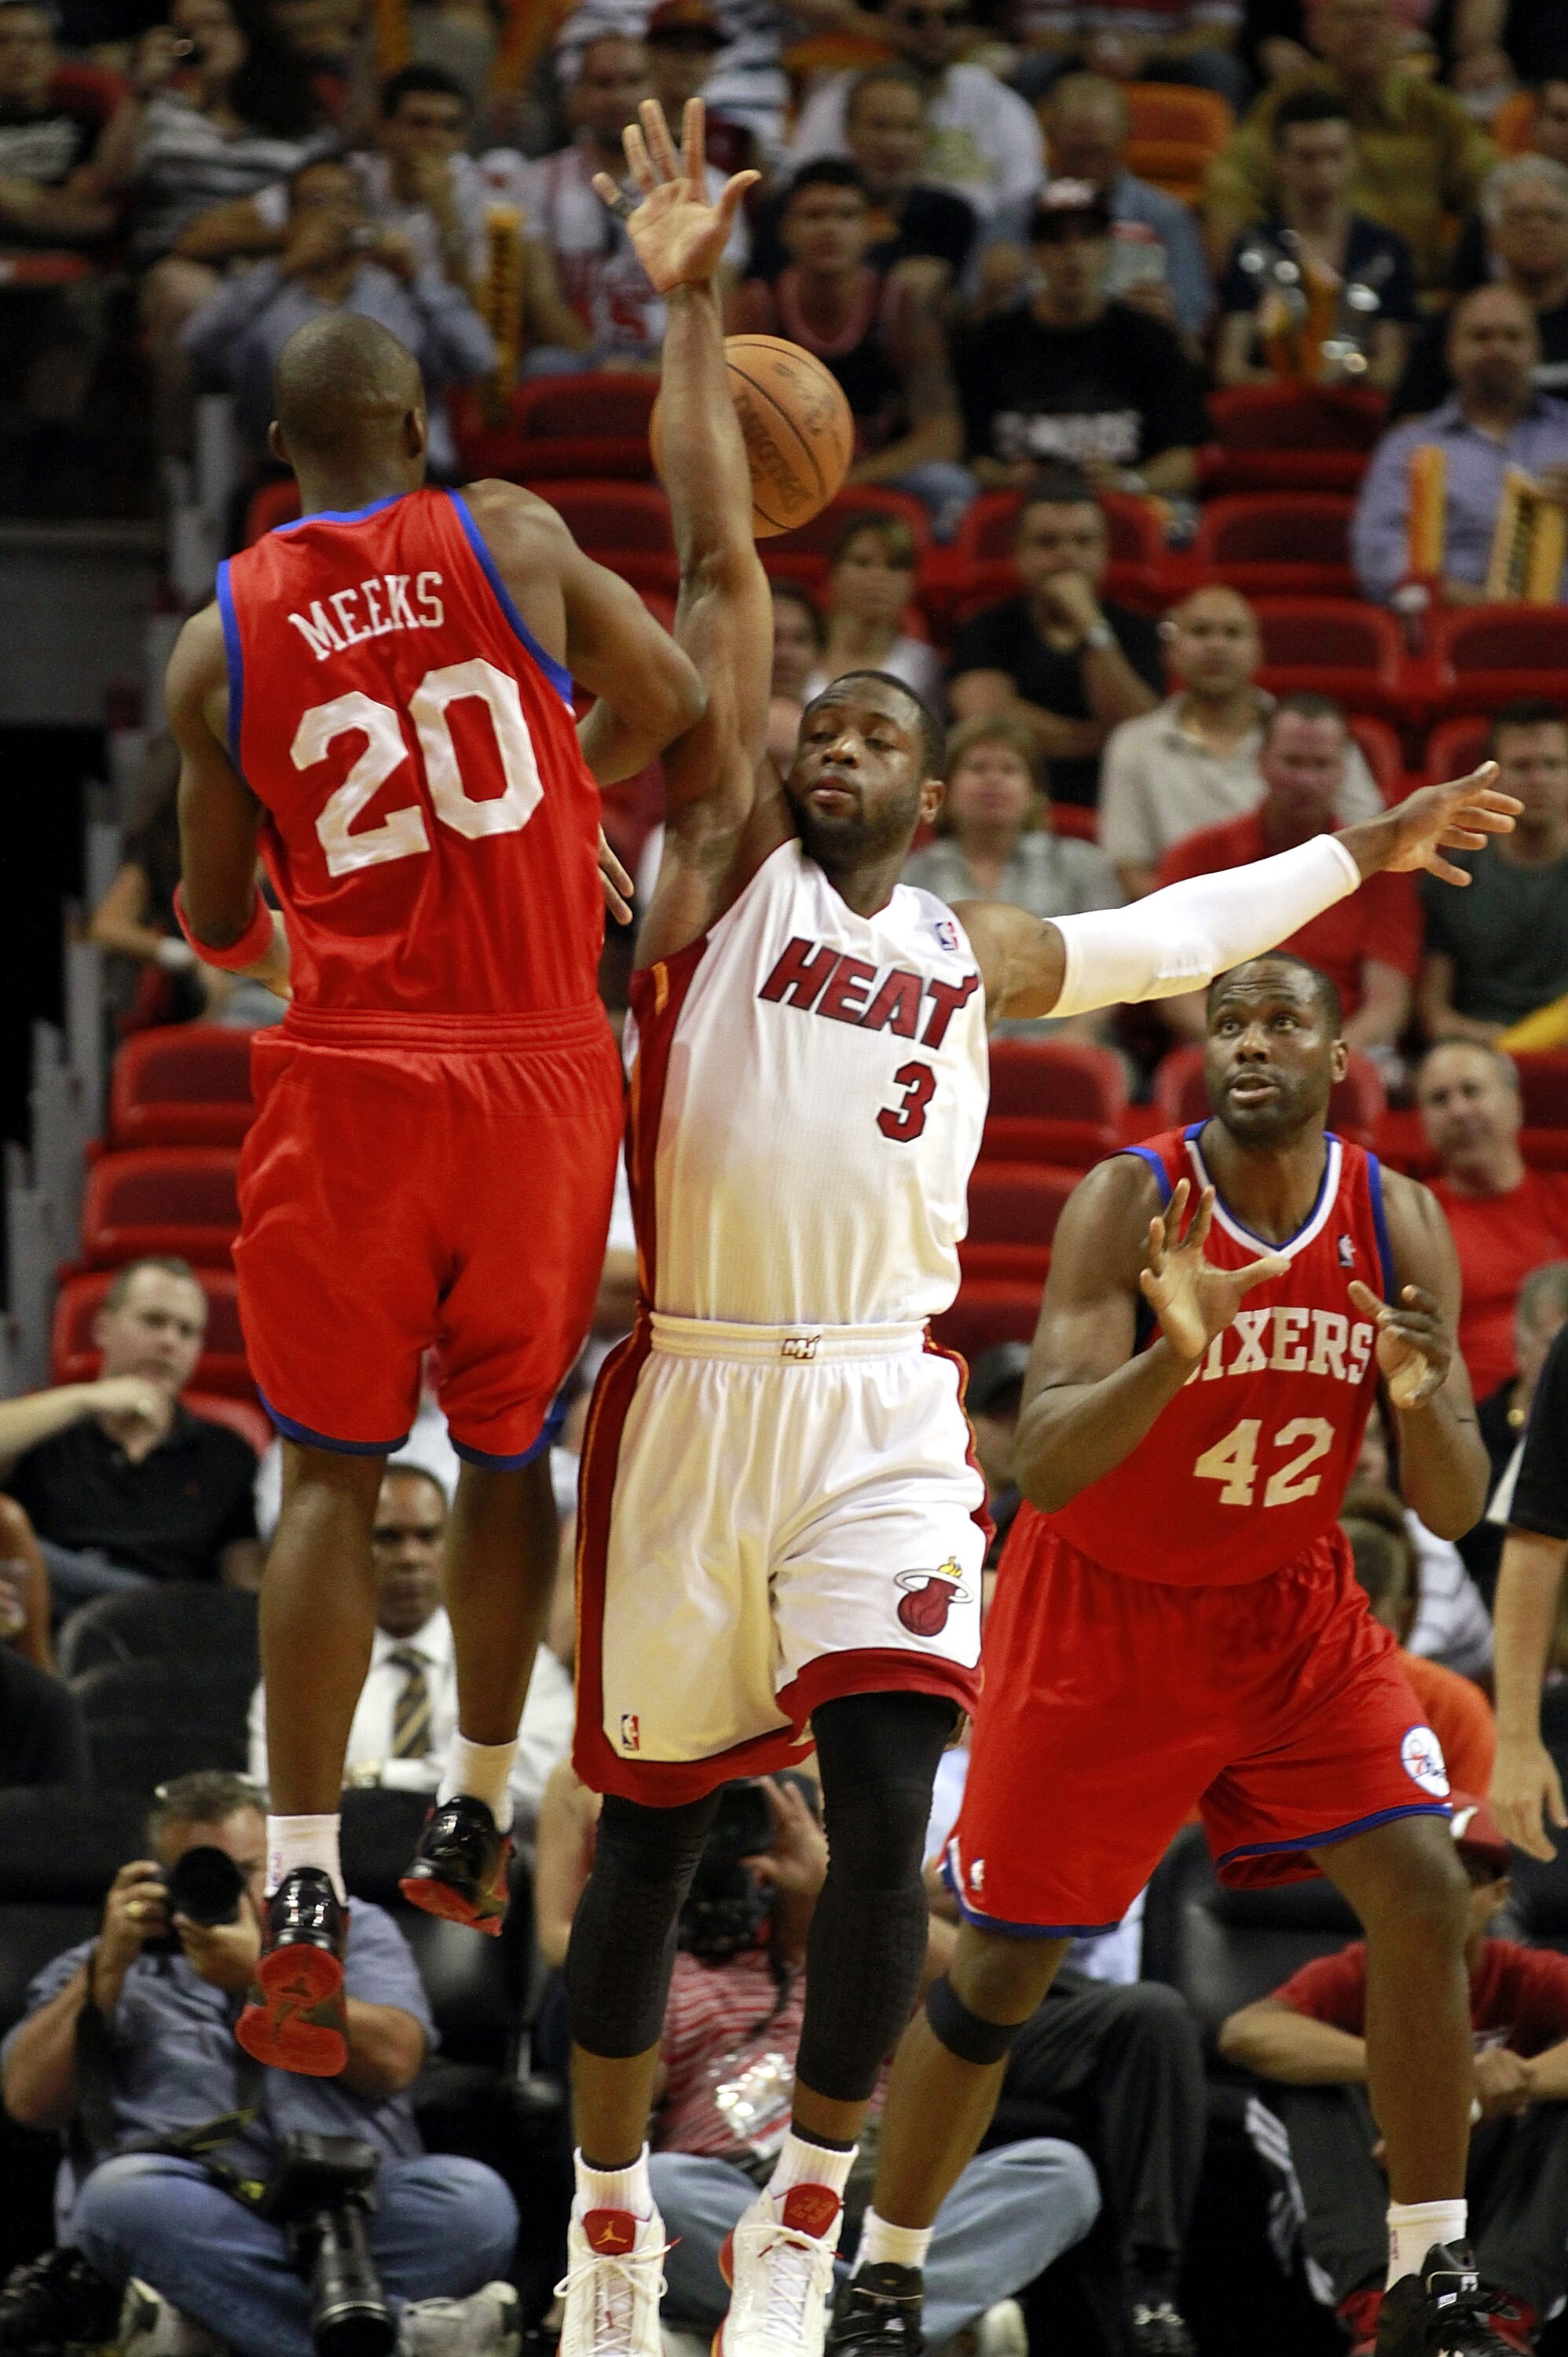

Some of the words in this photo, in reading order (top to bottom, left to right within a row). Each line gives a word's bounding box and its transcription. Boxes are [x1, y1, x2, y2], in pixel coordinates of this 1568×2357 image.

[288, 571, 444, 661] MEEKS
[289, 657, 545, 878] 20
[757, 936, 980, 1050] HEAT
[877, 1060, 937, 1143] 3
[1184, 1306, 1374, 1384] IXERS
[1192, 1417, 1335, 1508] 42
